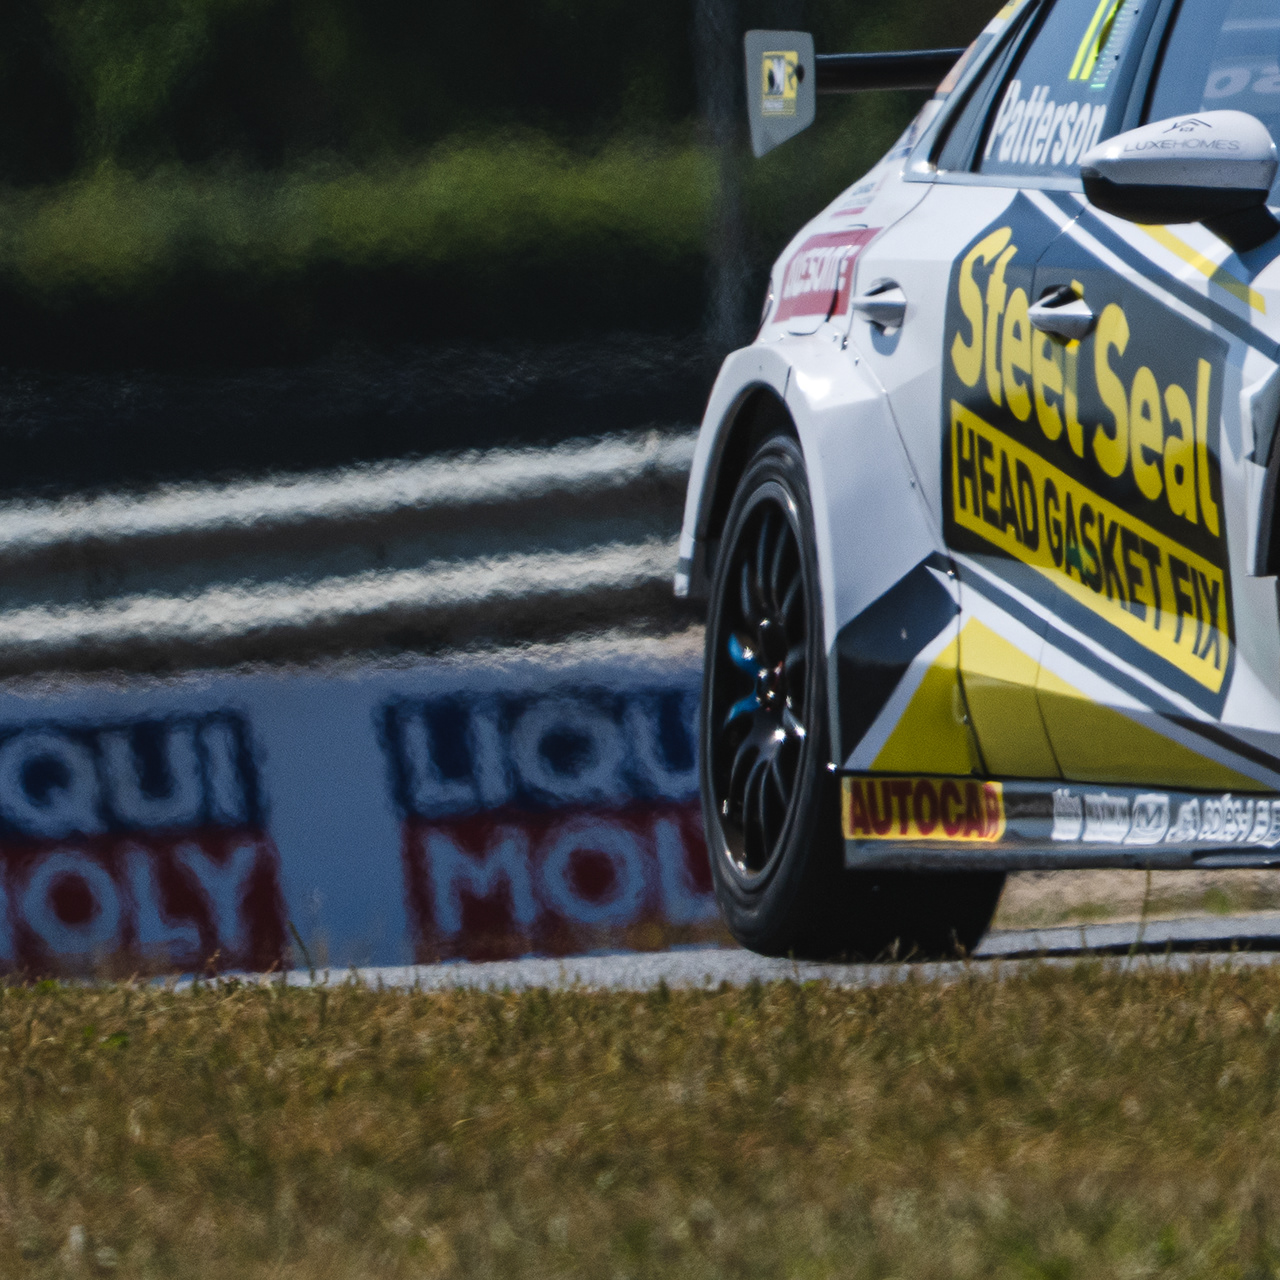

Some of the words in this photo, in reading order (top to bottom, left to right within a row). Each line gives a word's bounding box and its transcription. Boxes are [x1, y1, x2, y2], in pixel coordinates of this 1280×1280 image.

[984, 79, 1108, 167] Patterson
[950, 226, 1084, 458] Steel
[1092, 302, 1220, 538] Seal
[956, 420, 1040, 553] HEAD
[1043, 477, 1162, 632] GASKET
[1168, 553, 1223, 672] FIX
[405, 708, 700, 803] LIQU
[848, 779, 1002, 839] AUTOCAR
[0, 839, 255, 961] OLY
[425, 819, 717, 934] MOL
